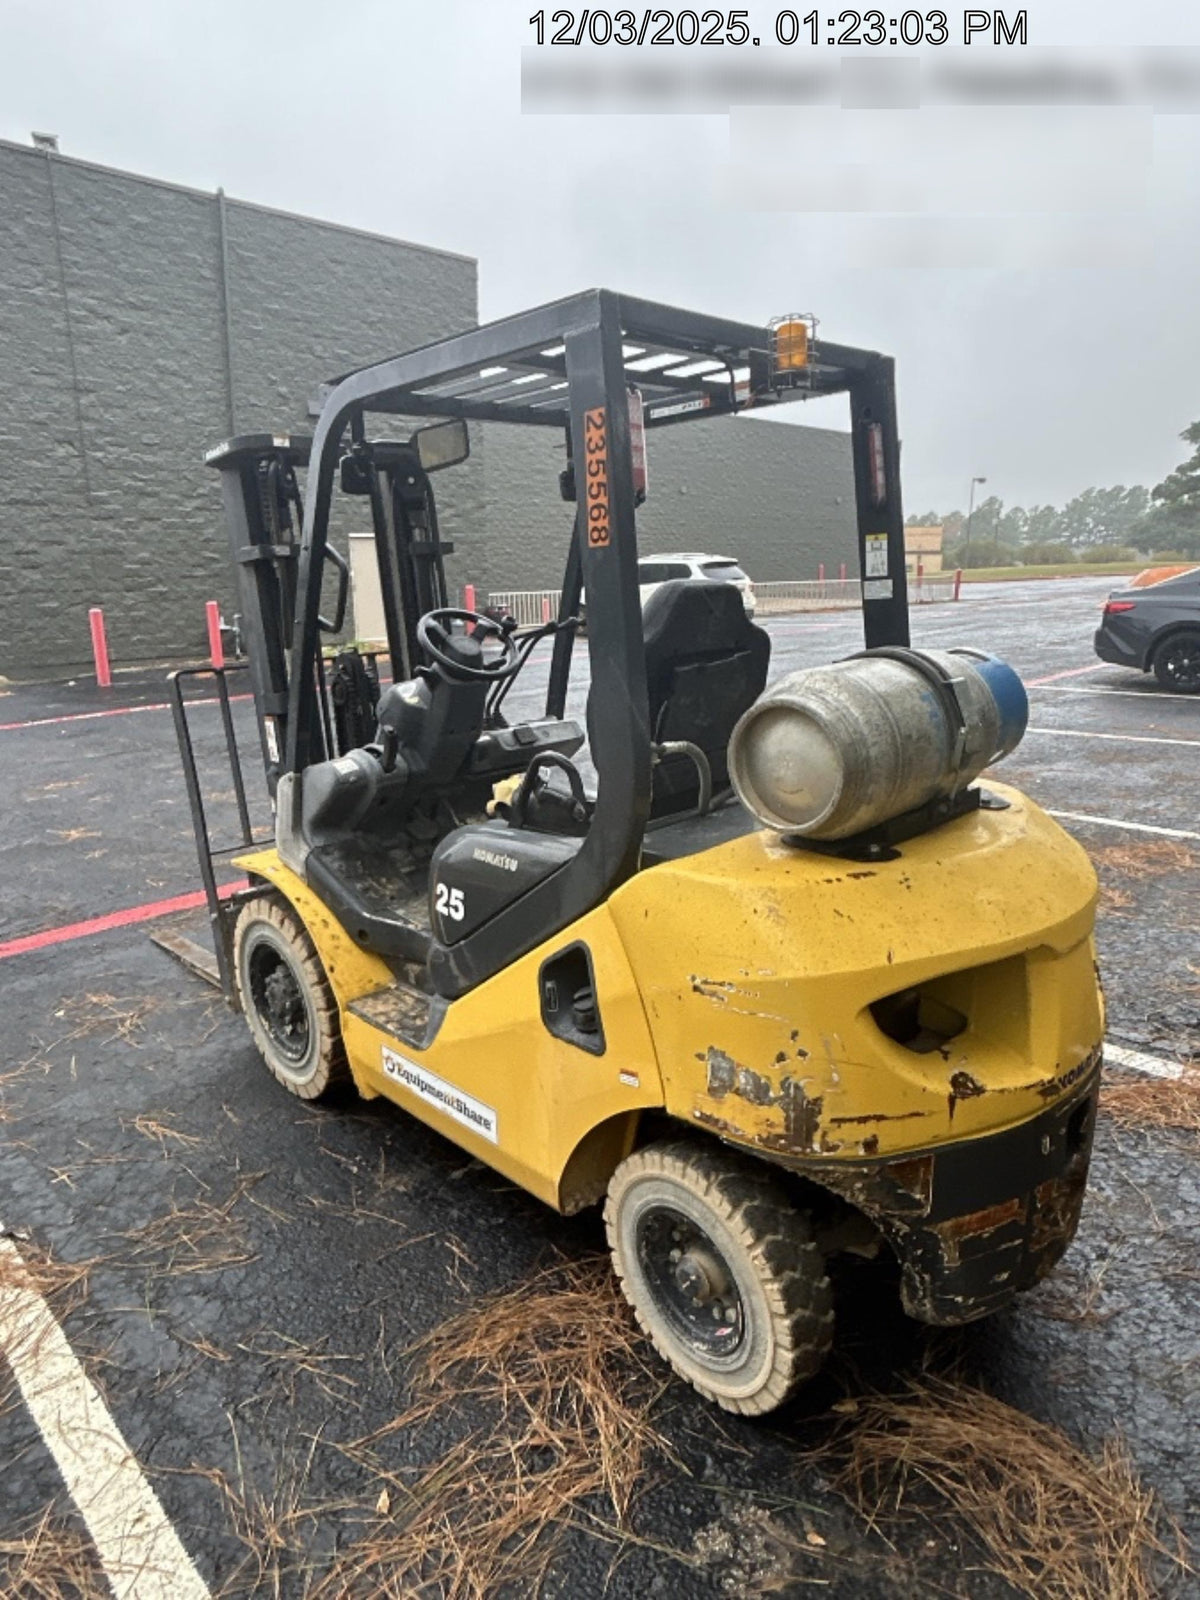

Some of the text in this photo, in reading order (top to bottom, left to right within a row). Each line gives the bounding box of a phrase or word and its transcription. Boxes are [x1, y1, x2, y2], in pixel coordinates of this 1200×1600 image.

[586, 412, 609, 544] 235568
[435, 882, 465, 921] 25
[395, 1061, 492, 1131] EquipmentShare
